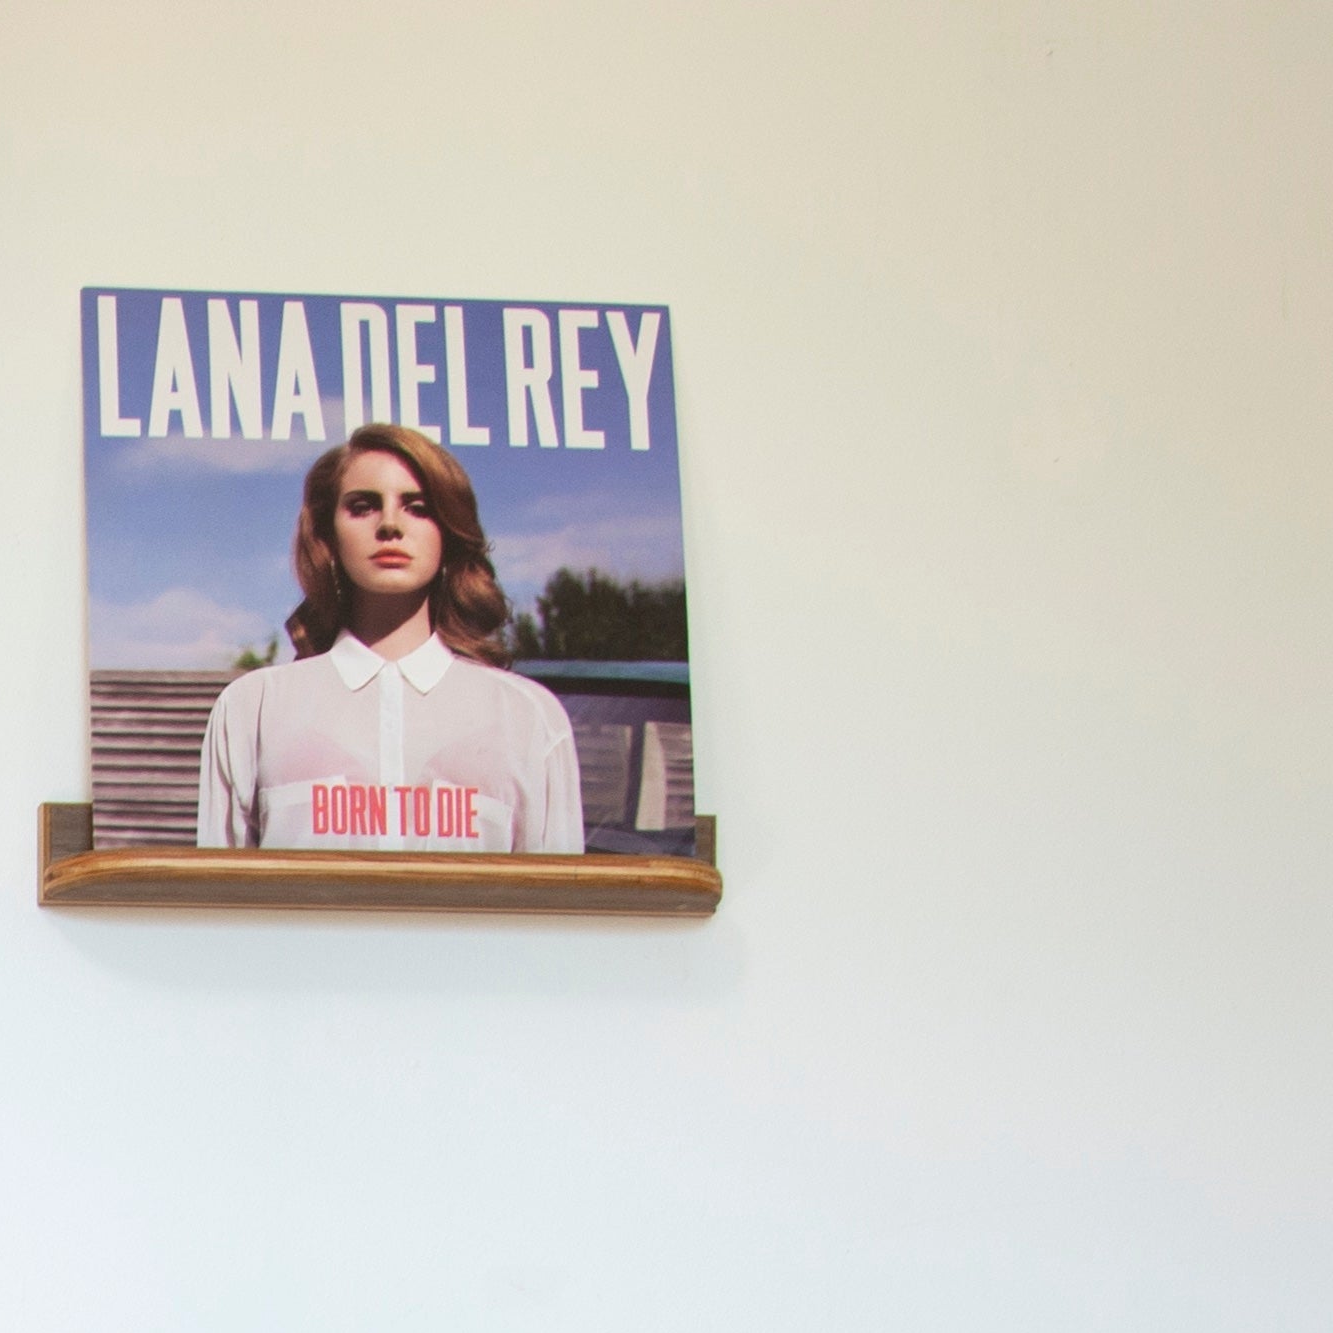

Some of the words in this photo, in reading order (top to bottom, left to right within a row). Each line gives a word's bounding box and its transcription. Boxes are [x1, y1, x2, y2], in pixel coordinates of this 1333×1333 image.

[97, 295, 327, 442] LANA
[340, 302, 489, 446] DEL
[503, 308, 661, 451] REY
[312, 784, 388, 837] BORN
[393, 786, 431, 838] TO
[438, 787, 480, 839] DIE
